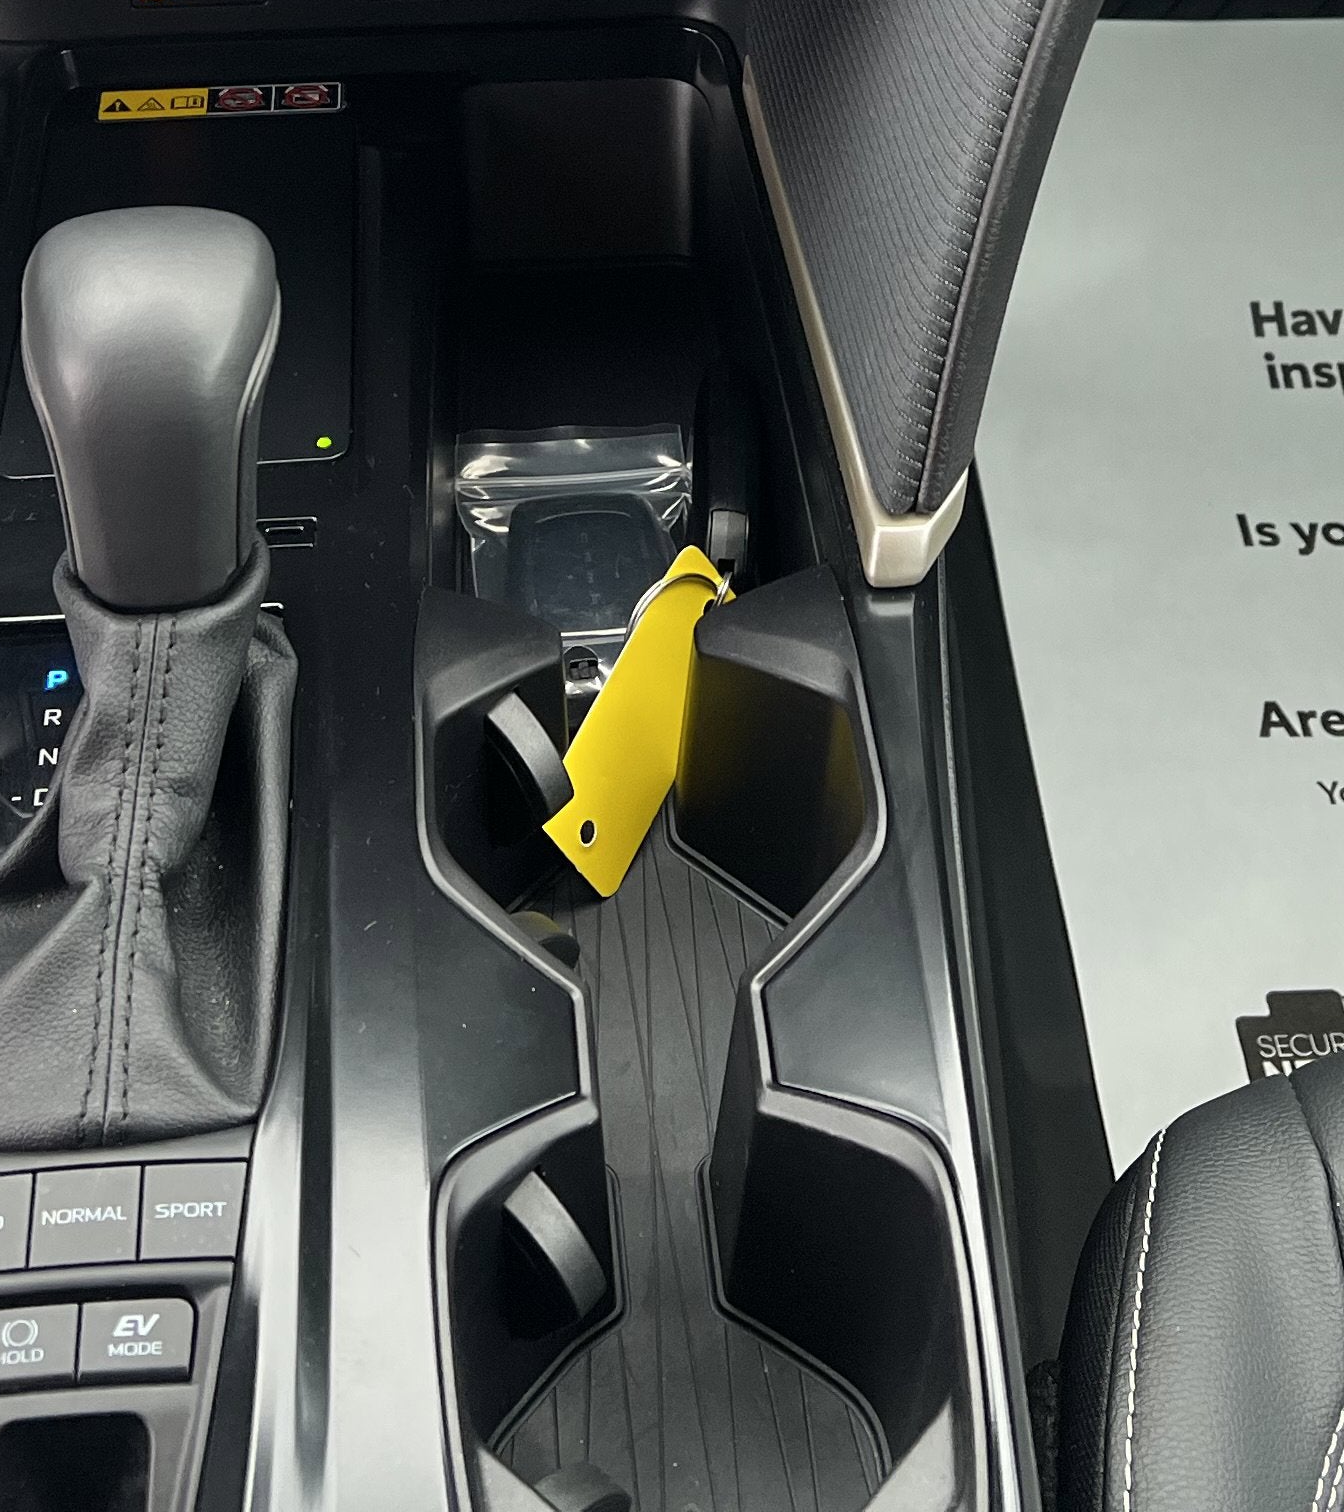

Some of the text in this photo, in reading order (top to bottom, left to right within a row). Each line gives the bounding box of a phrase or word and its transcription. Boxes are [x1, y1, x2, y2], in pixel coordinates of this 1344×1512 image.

[1235, 513, 1281, 547] Is
[47, 669, 68, 689] P
[43, 708, 62, 726] R
[38, 747, 59, 766] N
[41, 1205, 127, 1226] NORMAL
[154, 1200, 227, 1219] SPORT
[113, 1314, 160, 1338] EV
[107, 1340, 163, 1357] MODE
